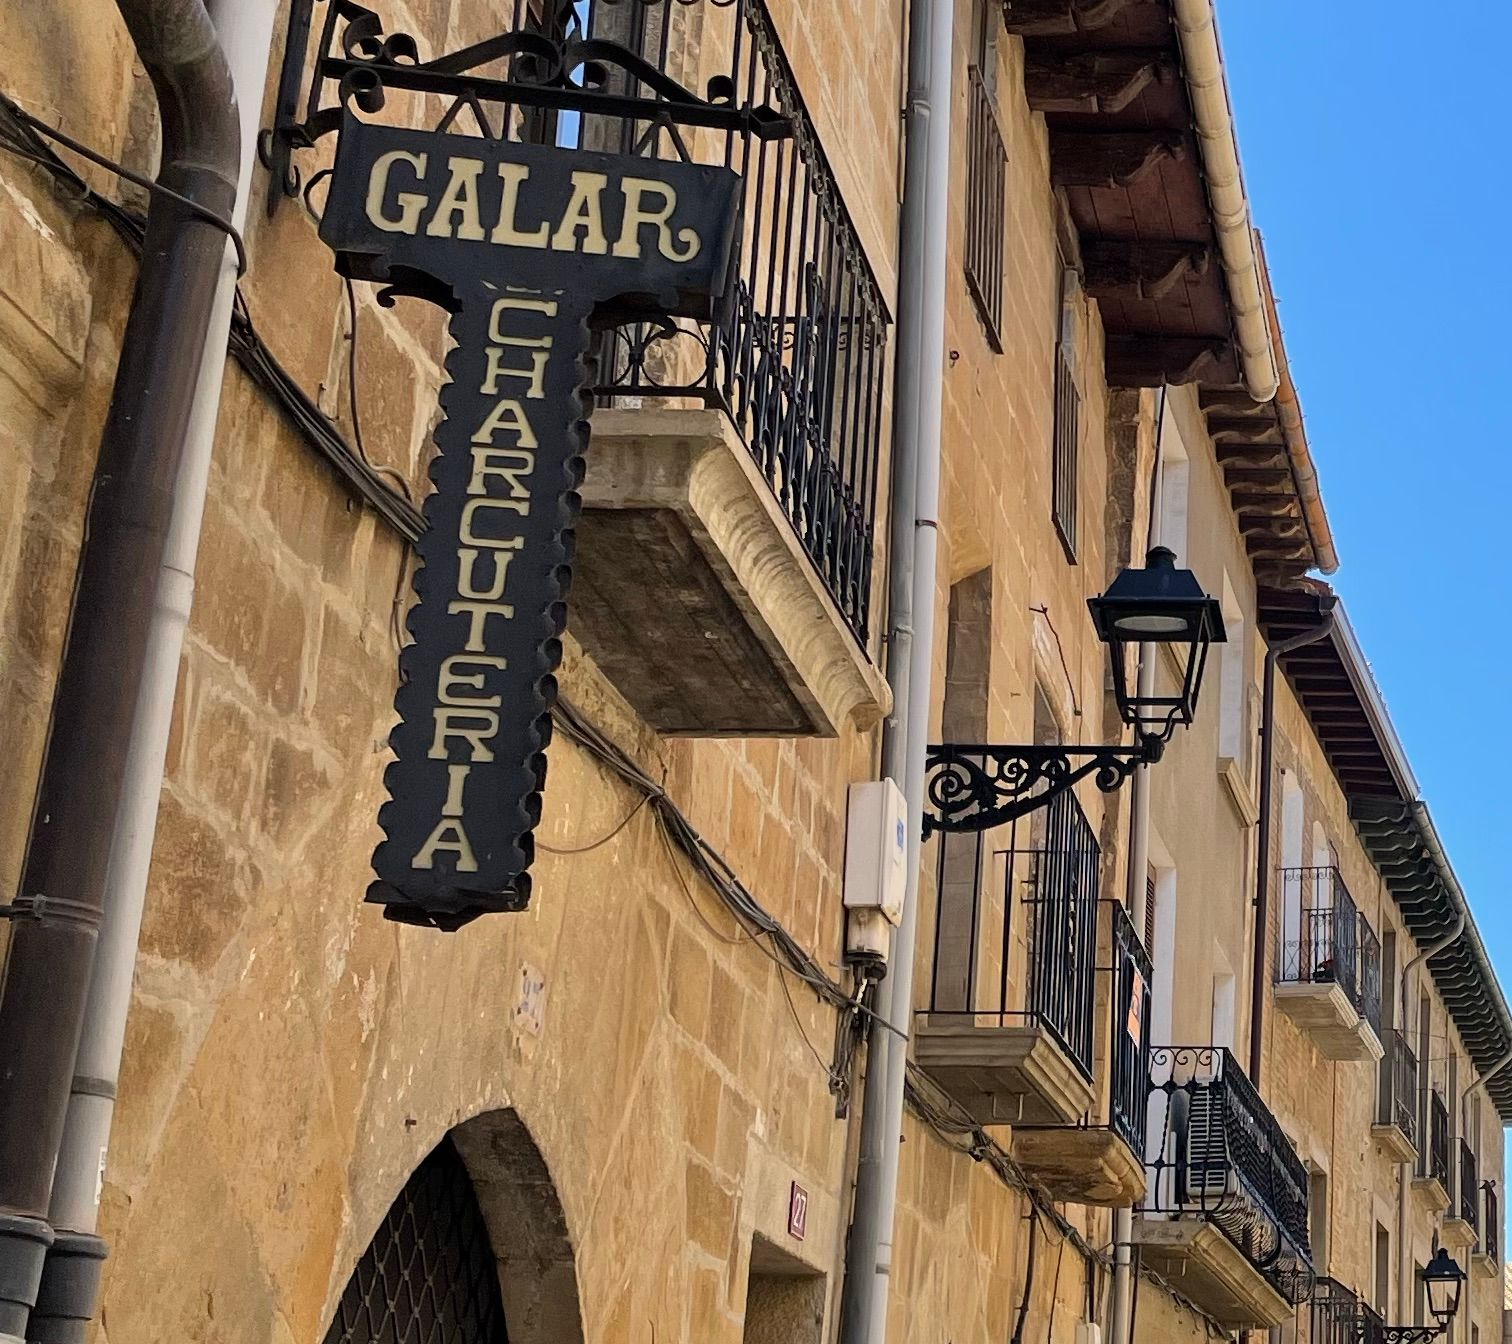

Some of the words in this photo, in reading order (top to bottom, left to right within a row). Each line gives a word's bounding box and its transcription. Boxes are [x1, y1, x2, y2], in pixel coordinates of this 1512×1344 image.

[365, 150, 701, 263] GALAR
[411, 297, 556, 873] CHARCUTERIA
[793, 1192, 807, 1229] 27
